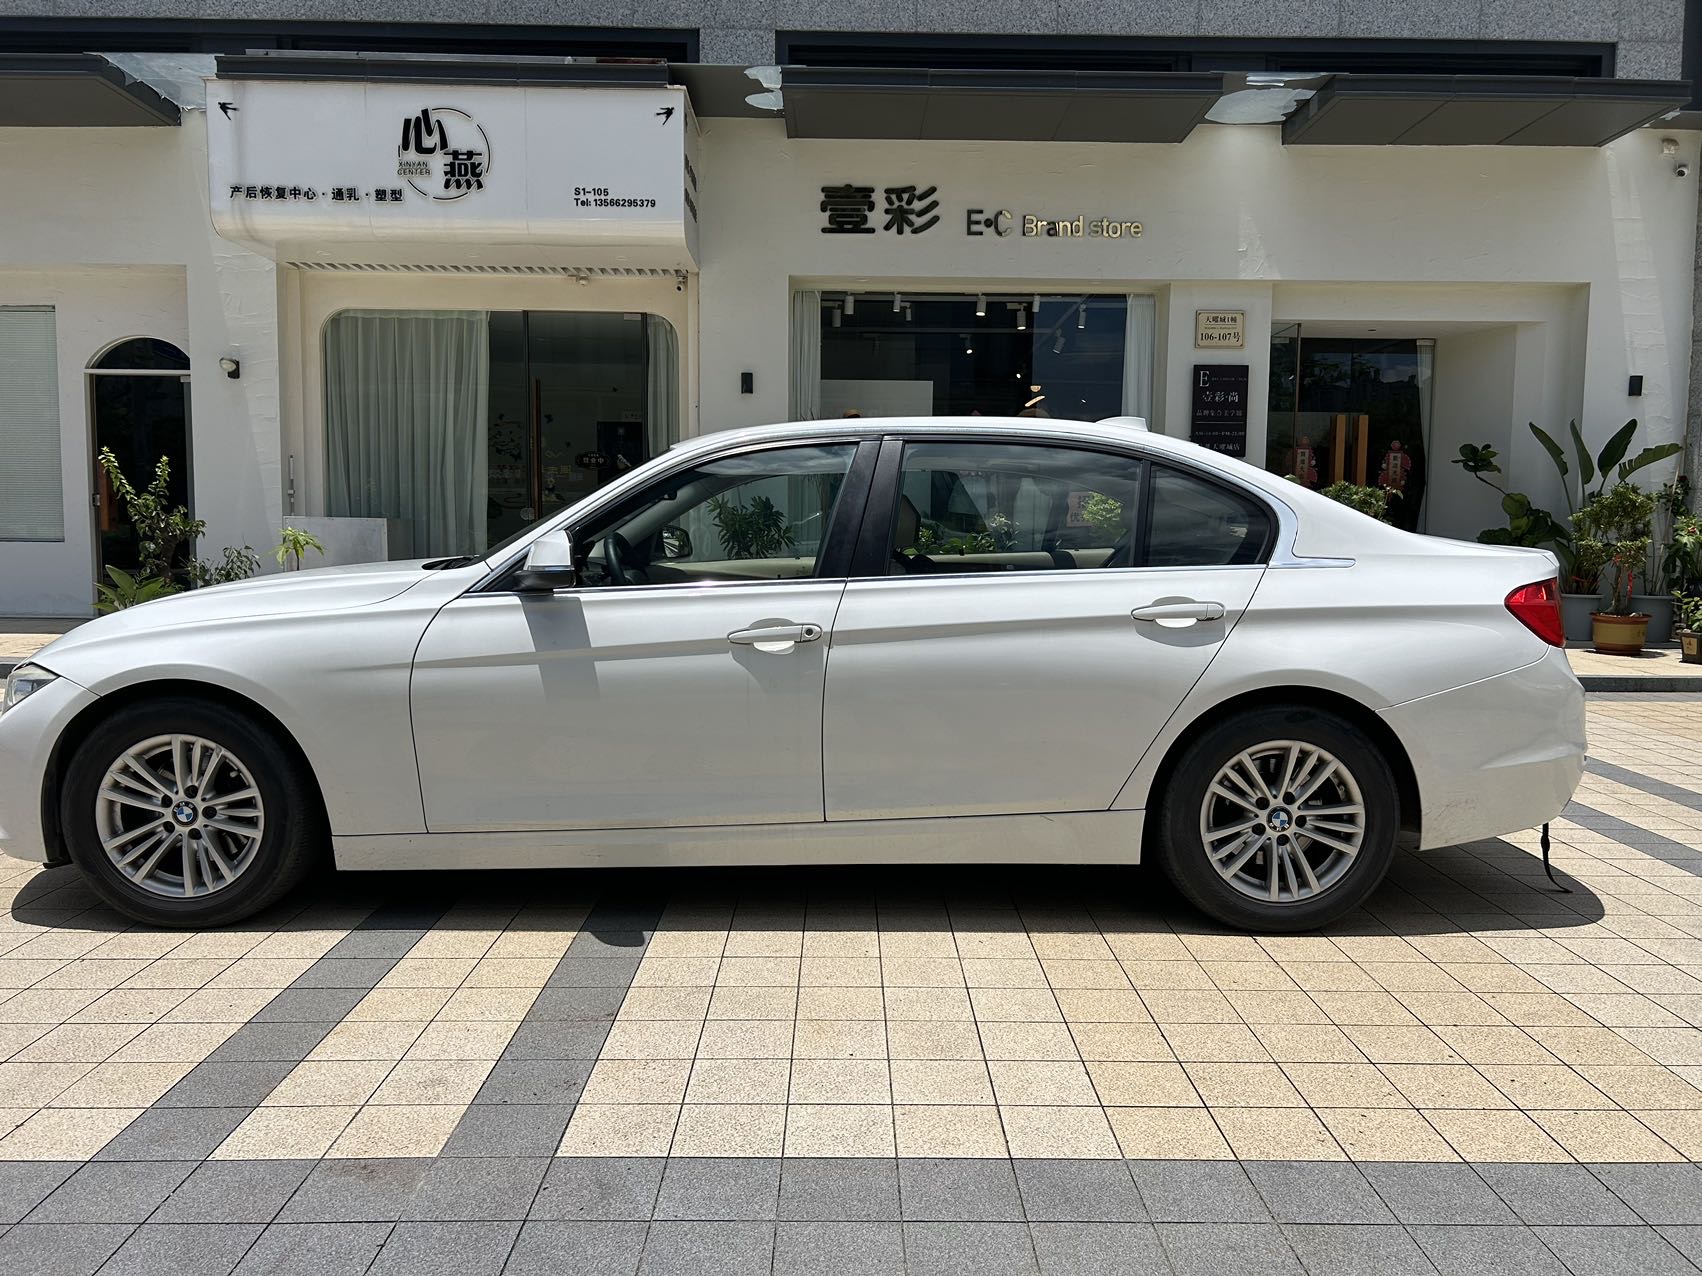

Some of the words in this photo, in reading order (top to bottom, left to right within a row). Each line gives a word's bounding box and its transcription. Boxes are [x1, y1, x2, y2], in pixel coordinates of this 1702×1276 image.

[574, 187, 609, 197] S1-105
[574, 198, 591, 207] Tel:
[593, 198, 656, 208] 13566295379
[820, 183, 940, 235] 壹彩
[1022, 214, 1084, 238] Brand
[1088, 215, 1143, 238] store
[1200, 370, 1210, 387] E
